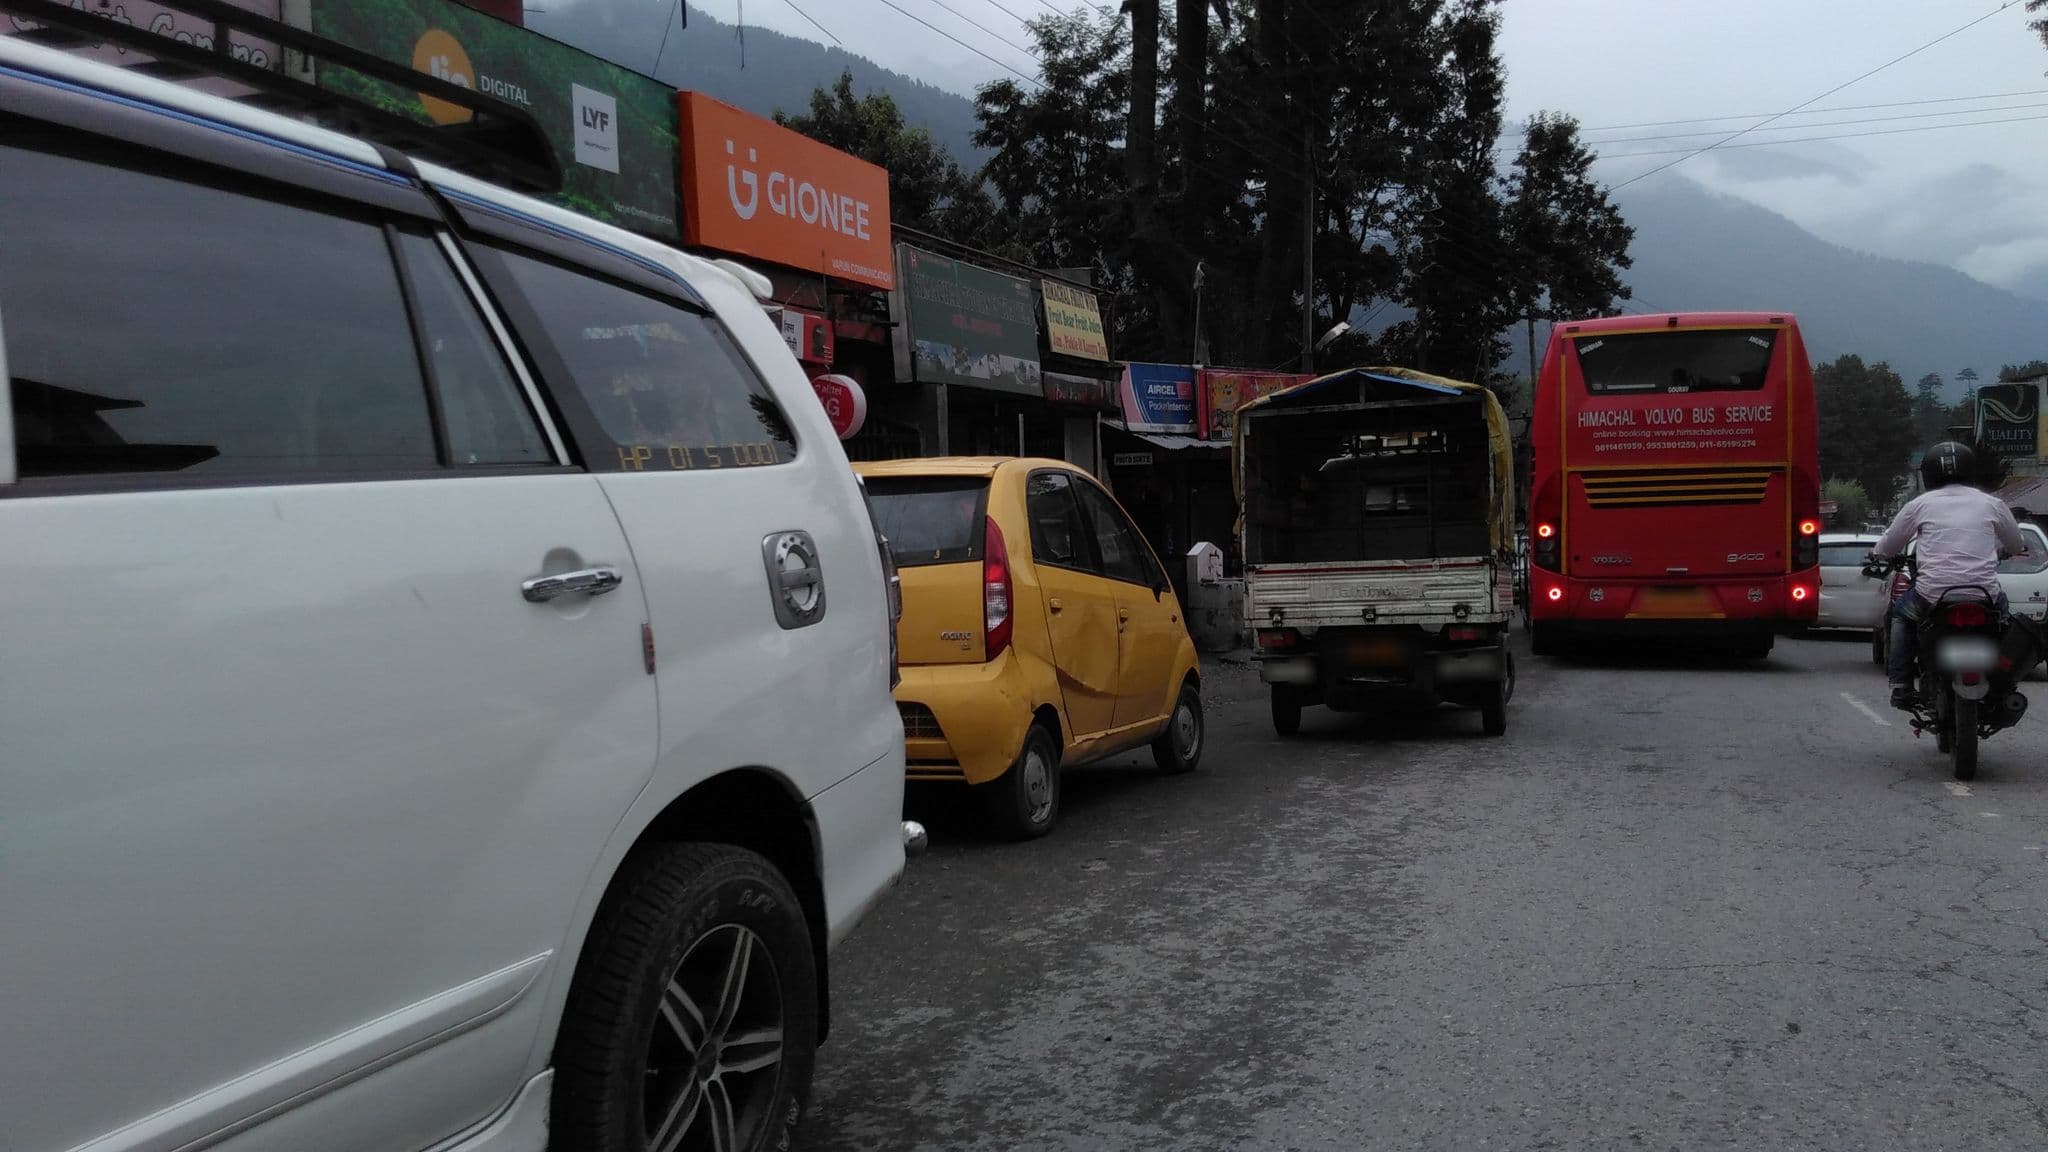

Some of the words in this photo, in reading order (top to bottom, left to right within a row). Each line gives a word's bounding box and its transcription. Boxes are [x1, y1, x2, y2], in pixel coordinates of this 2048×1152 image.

[481, 75, 531, 106] DIGITAL
[582, 105, 609, 132] LYF
[767, 171, 871, 241] GIONEE
[1147, 384, 1177, 396] AIRCEL
[1577, 408, 1637, 429] HIMACHAL
[1644, 407, 1683, 425] VOLVO
[1692, 407, 1716, 424] BUS
[1725, 405, 1772, 423] SERVICE
[1985, 428, 2033, 440] UALITY
[617, 444, 652, 471] HP
